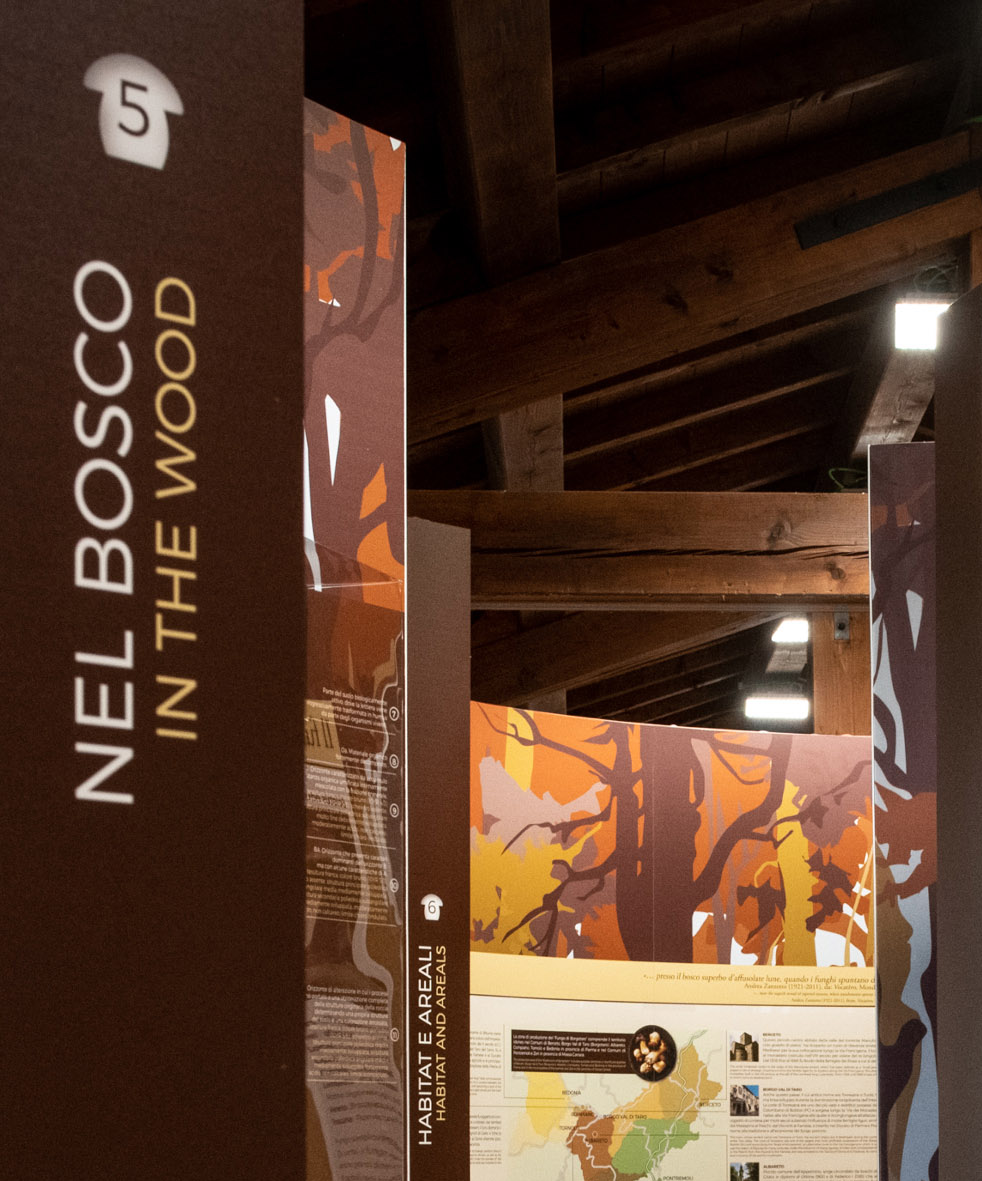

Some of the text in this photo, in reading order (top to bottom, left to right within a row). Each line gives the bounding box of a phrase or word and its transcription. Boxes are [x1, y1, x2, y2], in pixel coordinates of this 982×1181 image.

[118, 78, 149, 137] 5
[73, 260, 134, 804] NEL BOSCO
[155, 277, 197, 740] IN THE WOOD
[428, 900, 436, 914] 6
[418, 945, 432, 1145] HABITAT E AREALI
[436, 945, 446, 1121] HABITAT AND AREALS
